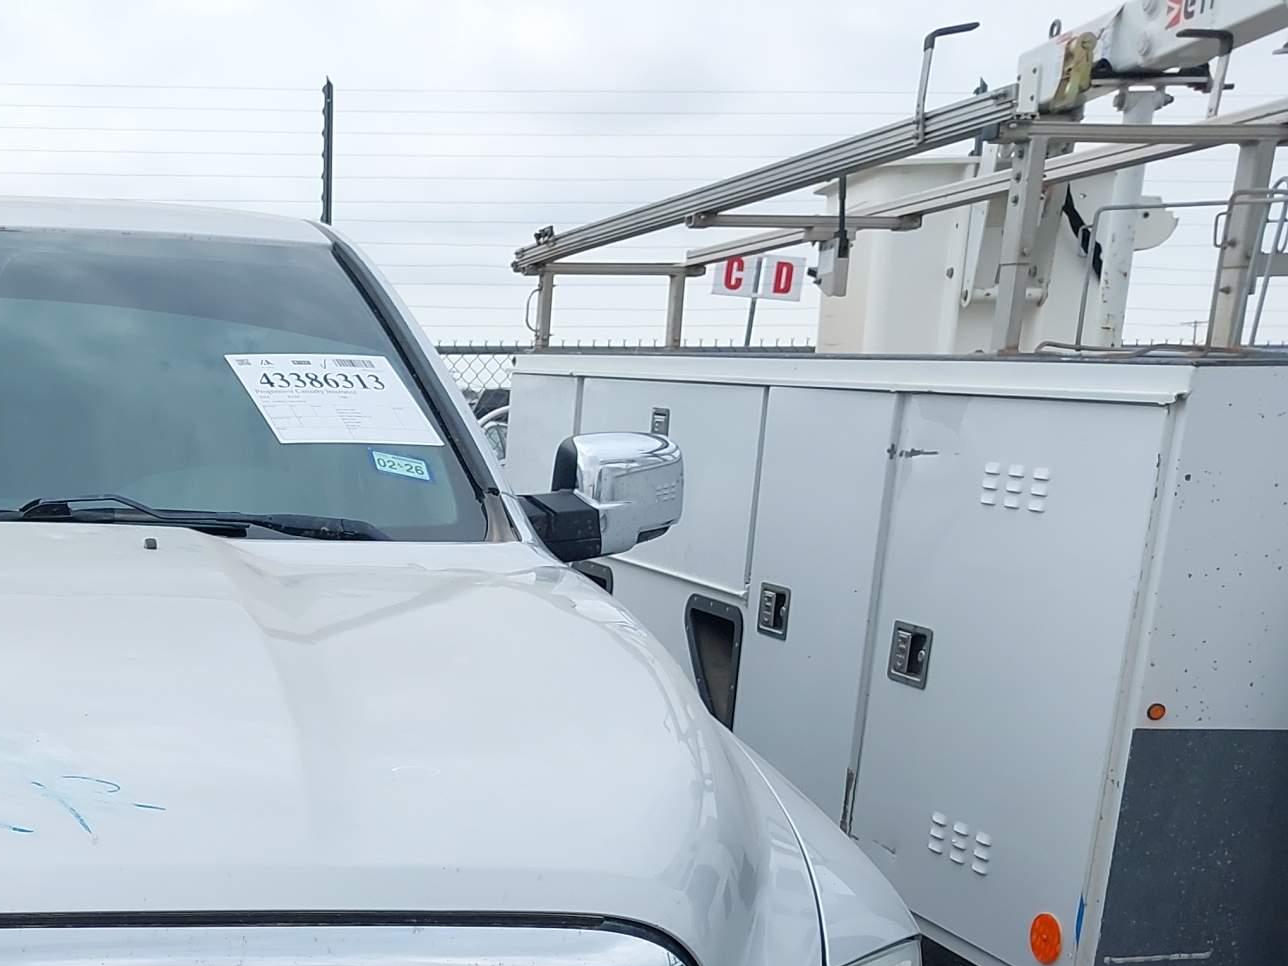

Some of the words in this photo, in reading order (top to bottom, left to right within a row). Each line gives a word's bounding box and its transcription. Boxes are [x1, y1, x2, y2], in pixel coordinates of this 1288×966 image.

[724, 256, 744, 290] C
[773, 261, 794, 294] D
[259, 372, 385, 391] 43386313
